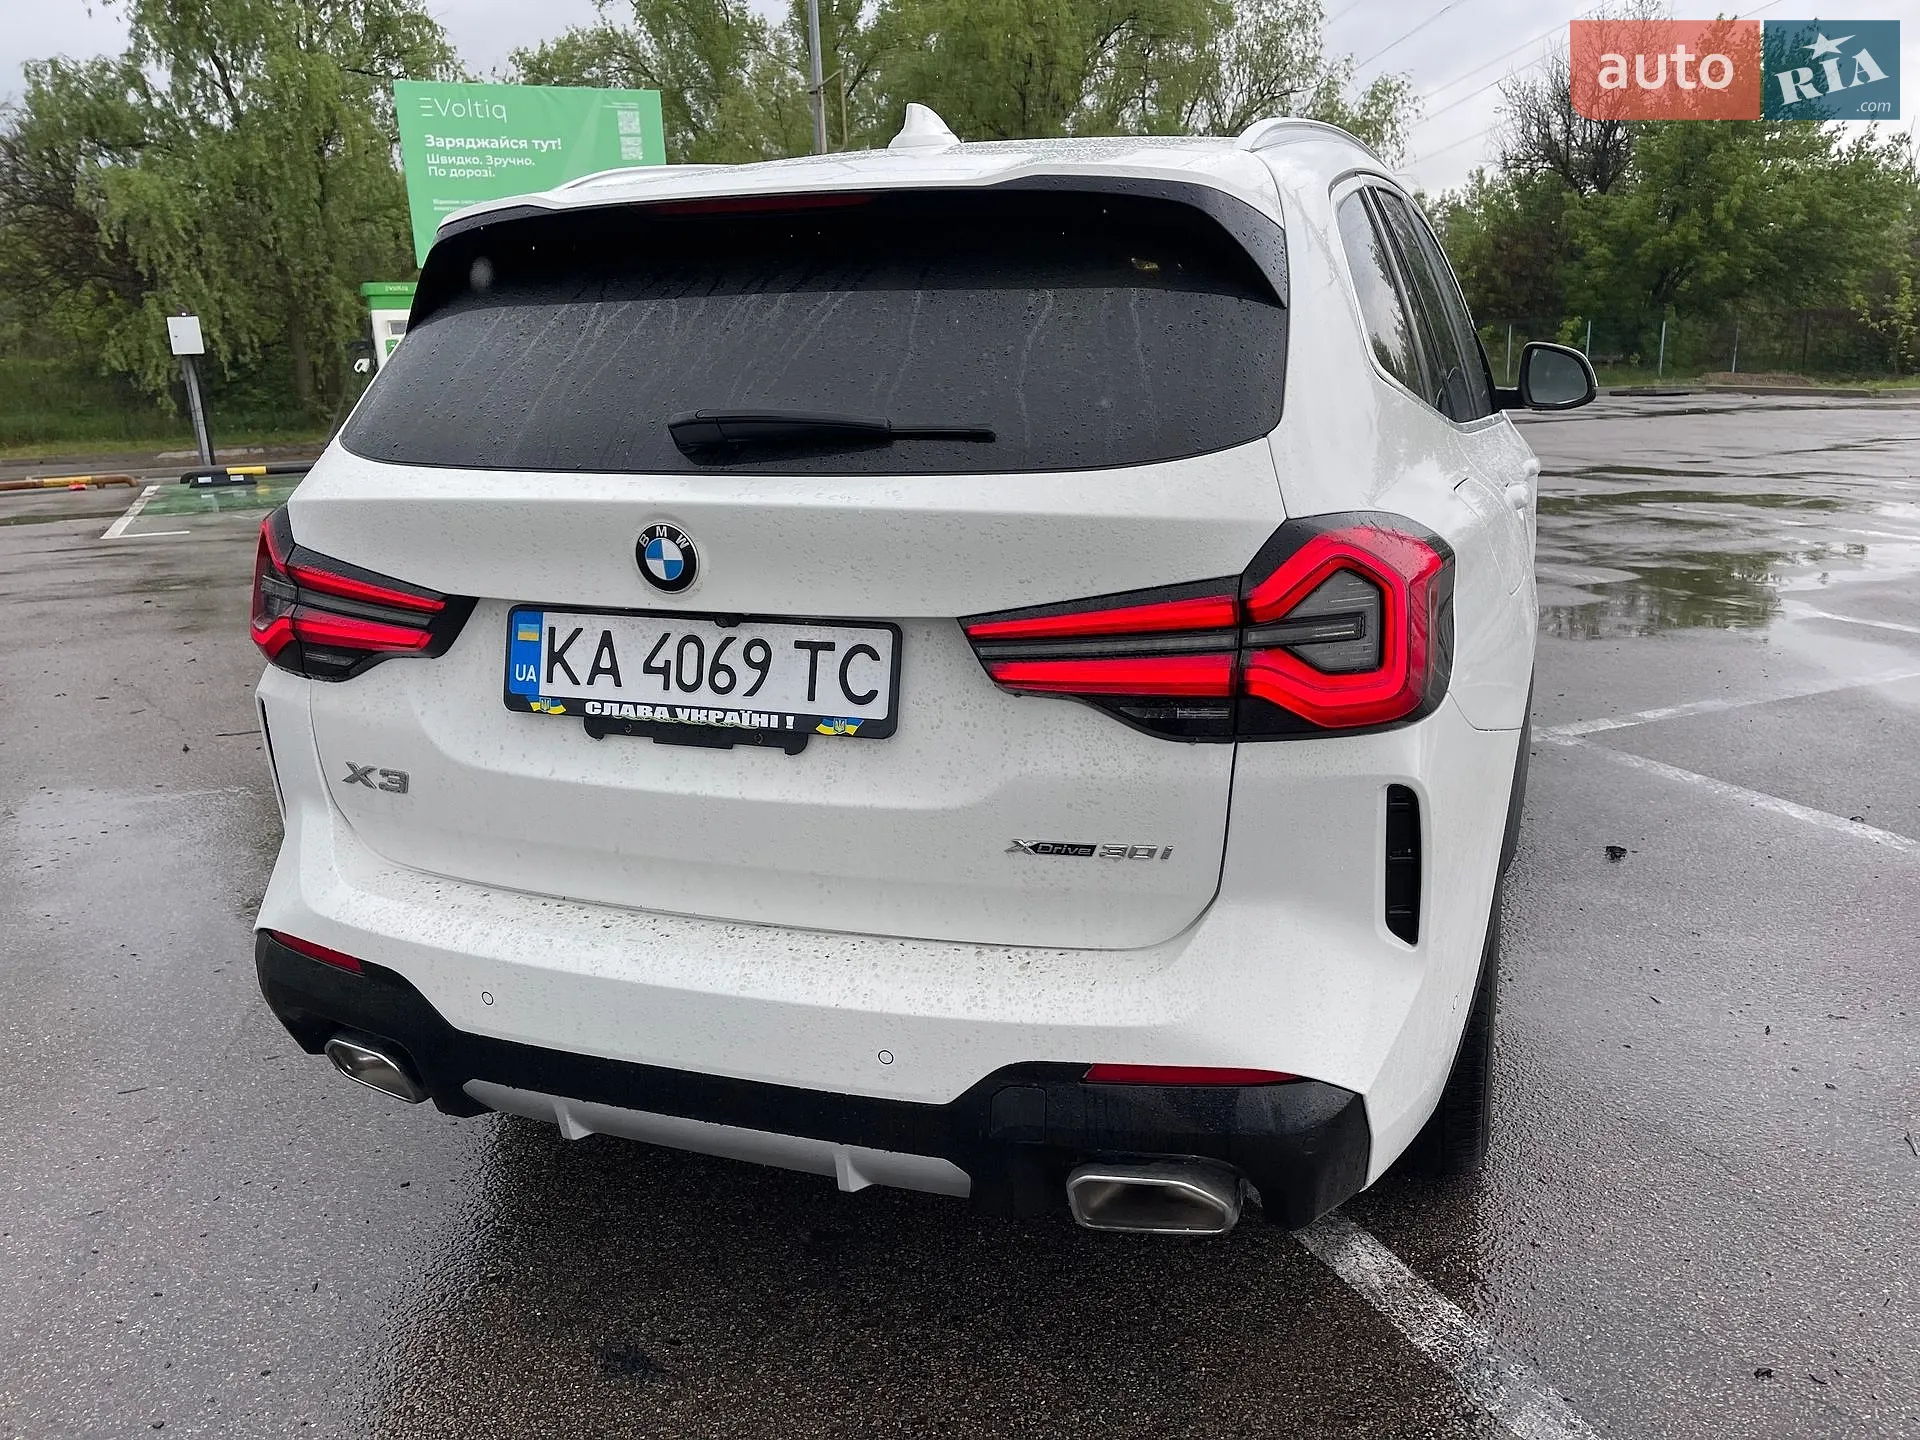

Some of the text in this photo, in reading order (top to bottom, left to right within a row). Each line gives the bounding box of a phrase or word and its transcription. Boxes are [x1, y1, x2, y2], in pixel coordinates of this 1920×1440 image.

[424, 134, 563, 153] Заряджайся тут!
[426, 153, 536, 168] Швидко. Зручно.
[428, 166, 496, 179] По дорозі.
[638, 525, 690, 549] BMW
[515, 663, 537, 683] UA
[545, 626, 882, 706] KA 4069 TC
[584, 700, 670, 719] СЛАВА
[674, 707, 779, 730] УКРАЇНІ
[341, 761, 410, 794] X3
